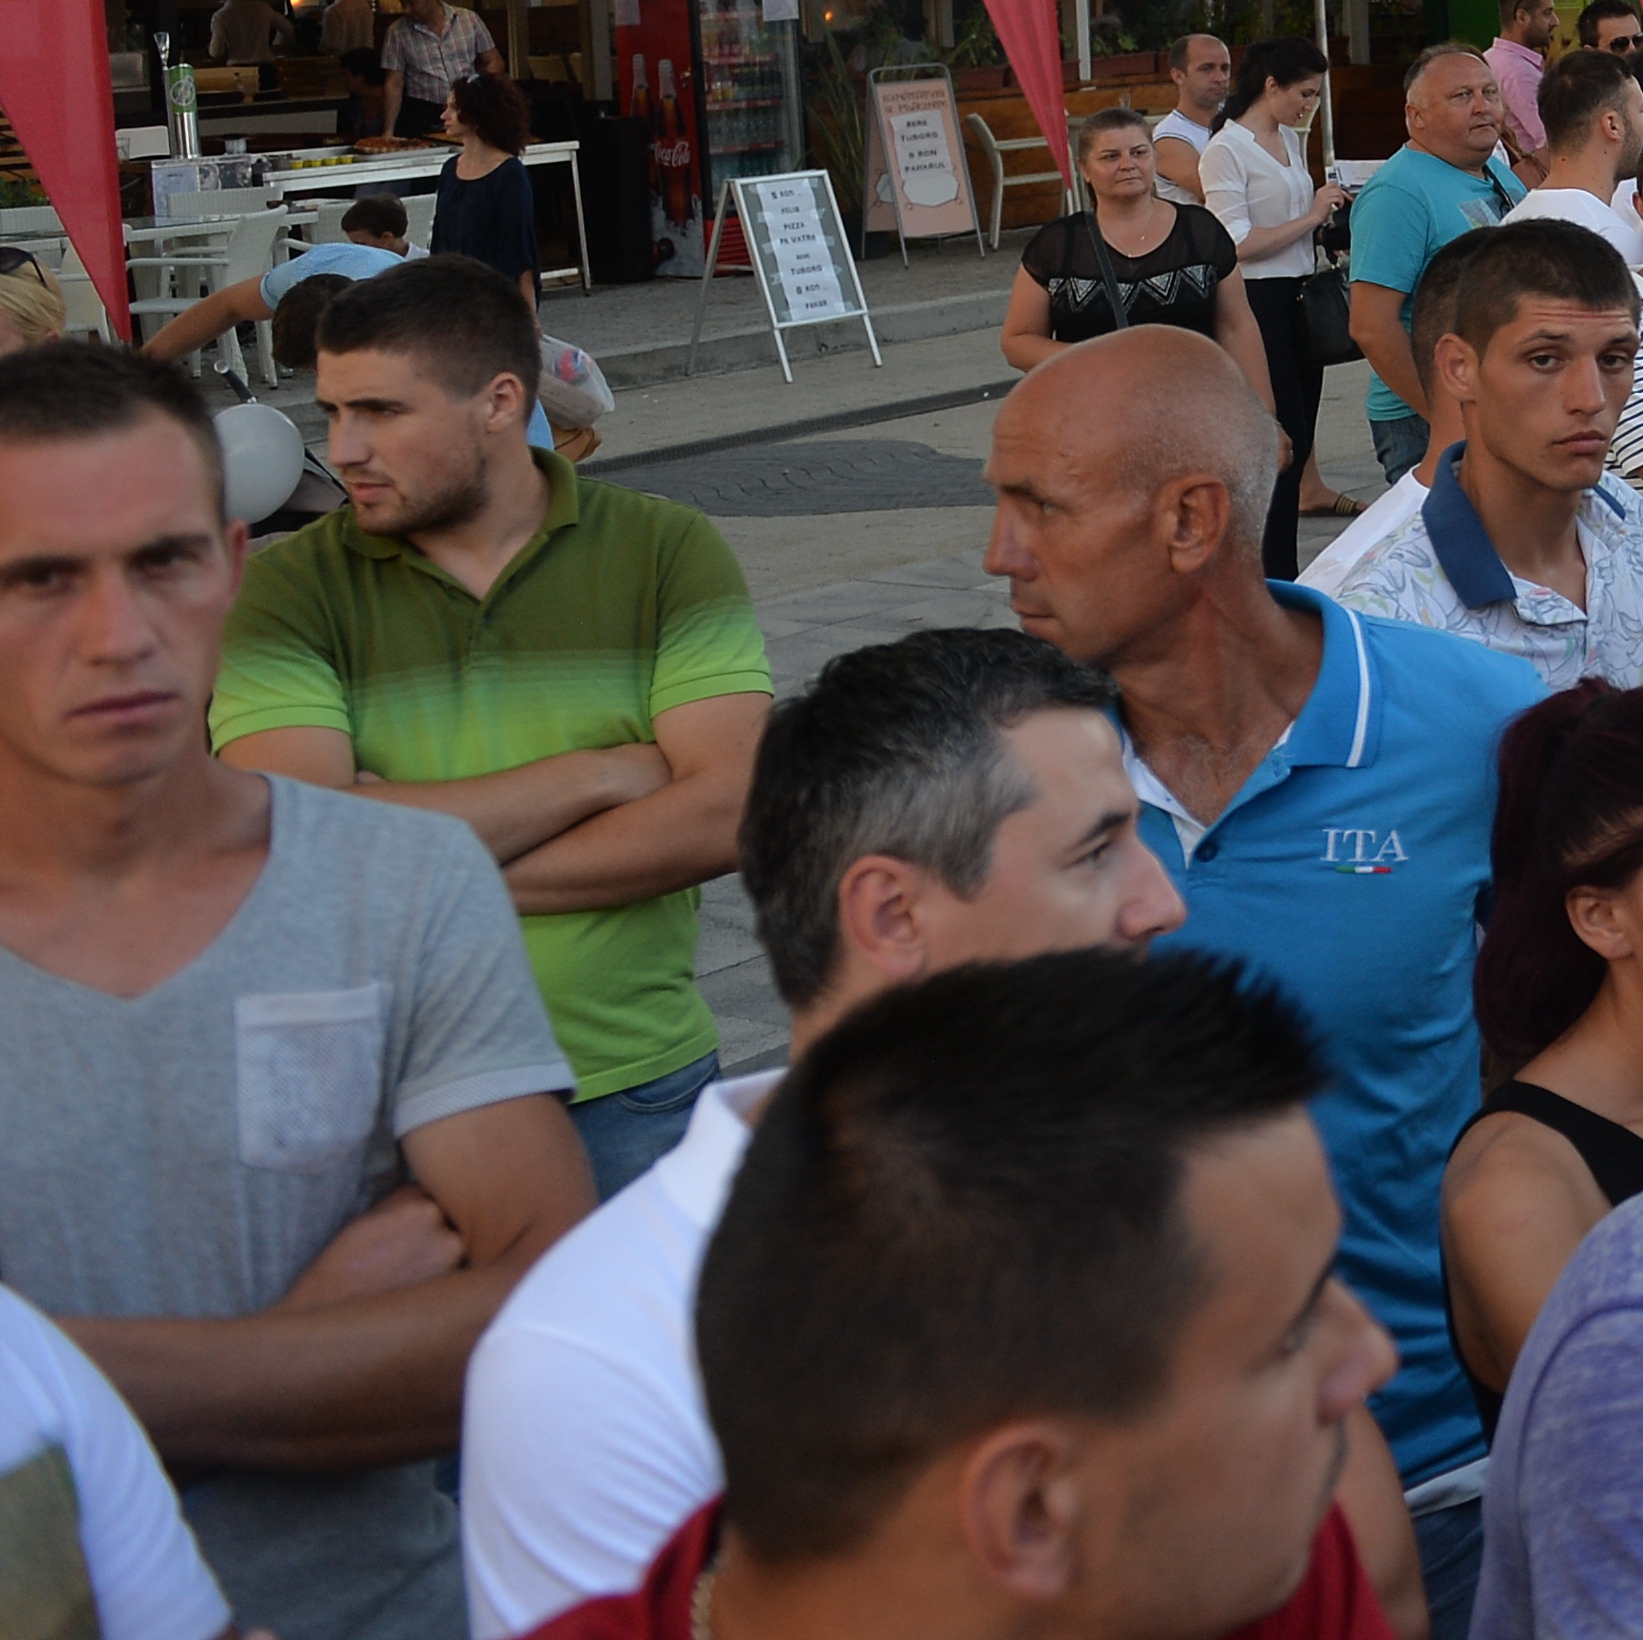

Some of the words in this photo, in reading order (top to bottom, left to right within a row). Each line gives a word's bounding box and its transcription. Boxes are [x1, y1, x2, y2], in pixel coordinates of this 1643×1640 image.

[901, 131, 939, 142] TUBORG
[917, 149, 938, 157] RON
[783, 222, 805, 231] PIZZA
[1319, 828, 1411, 862] ITA
